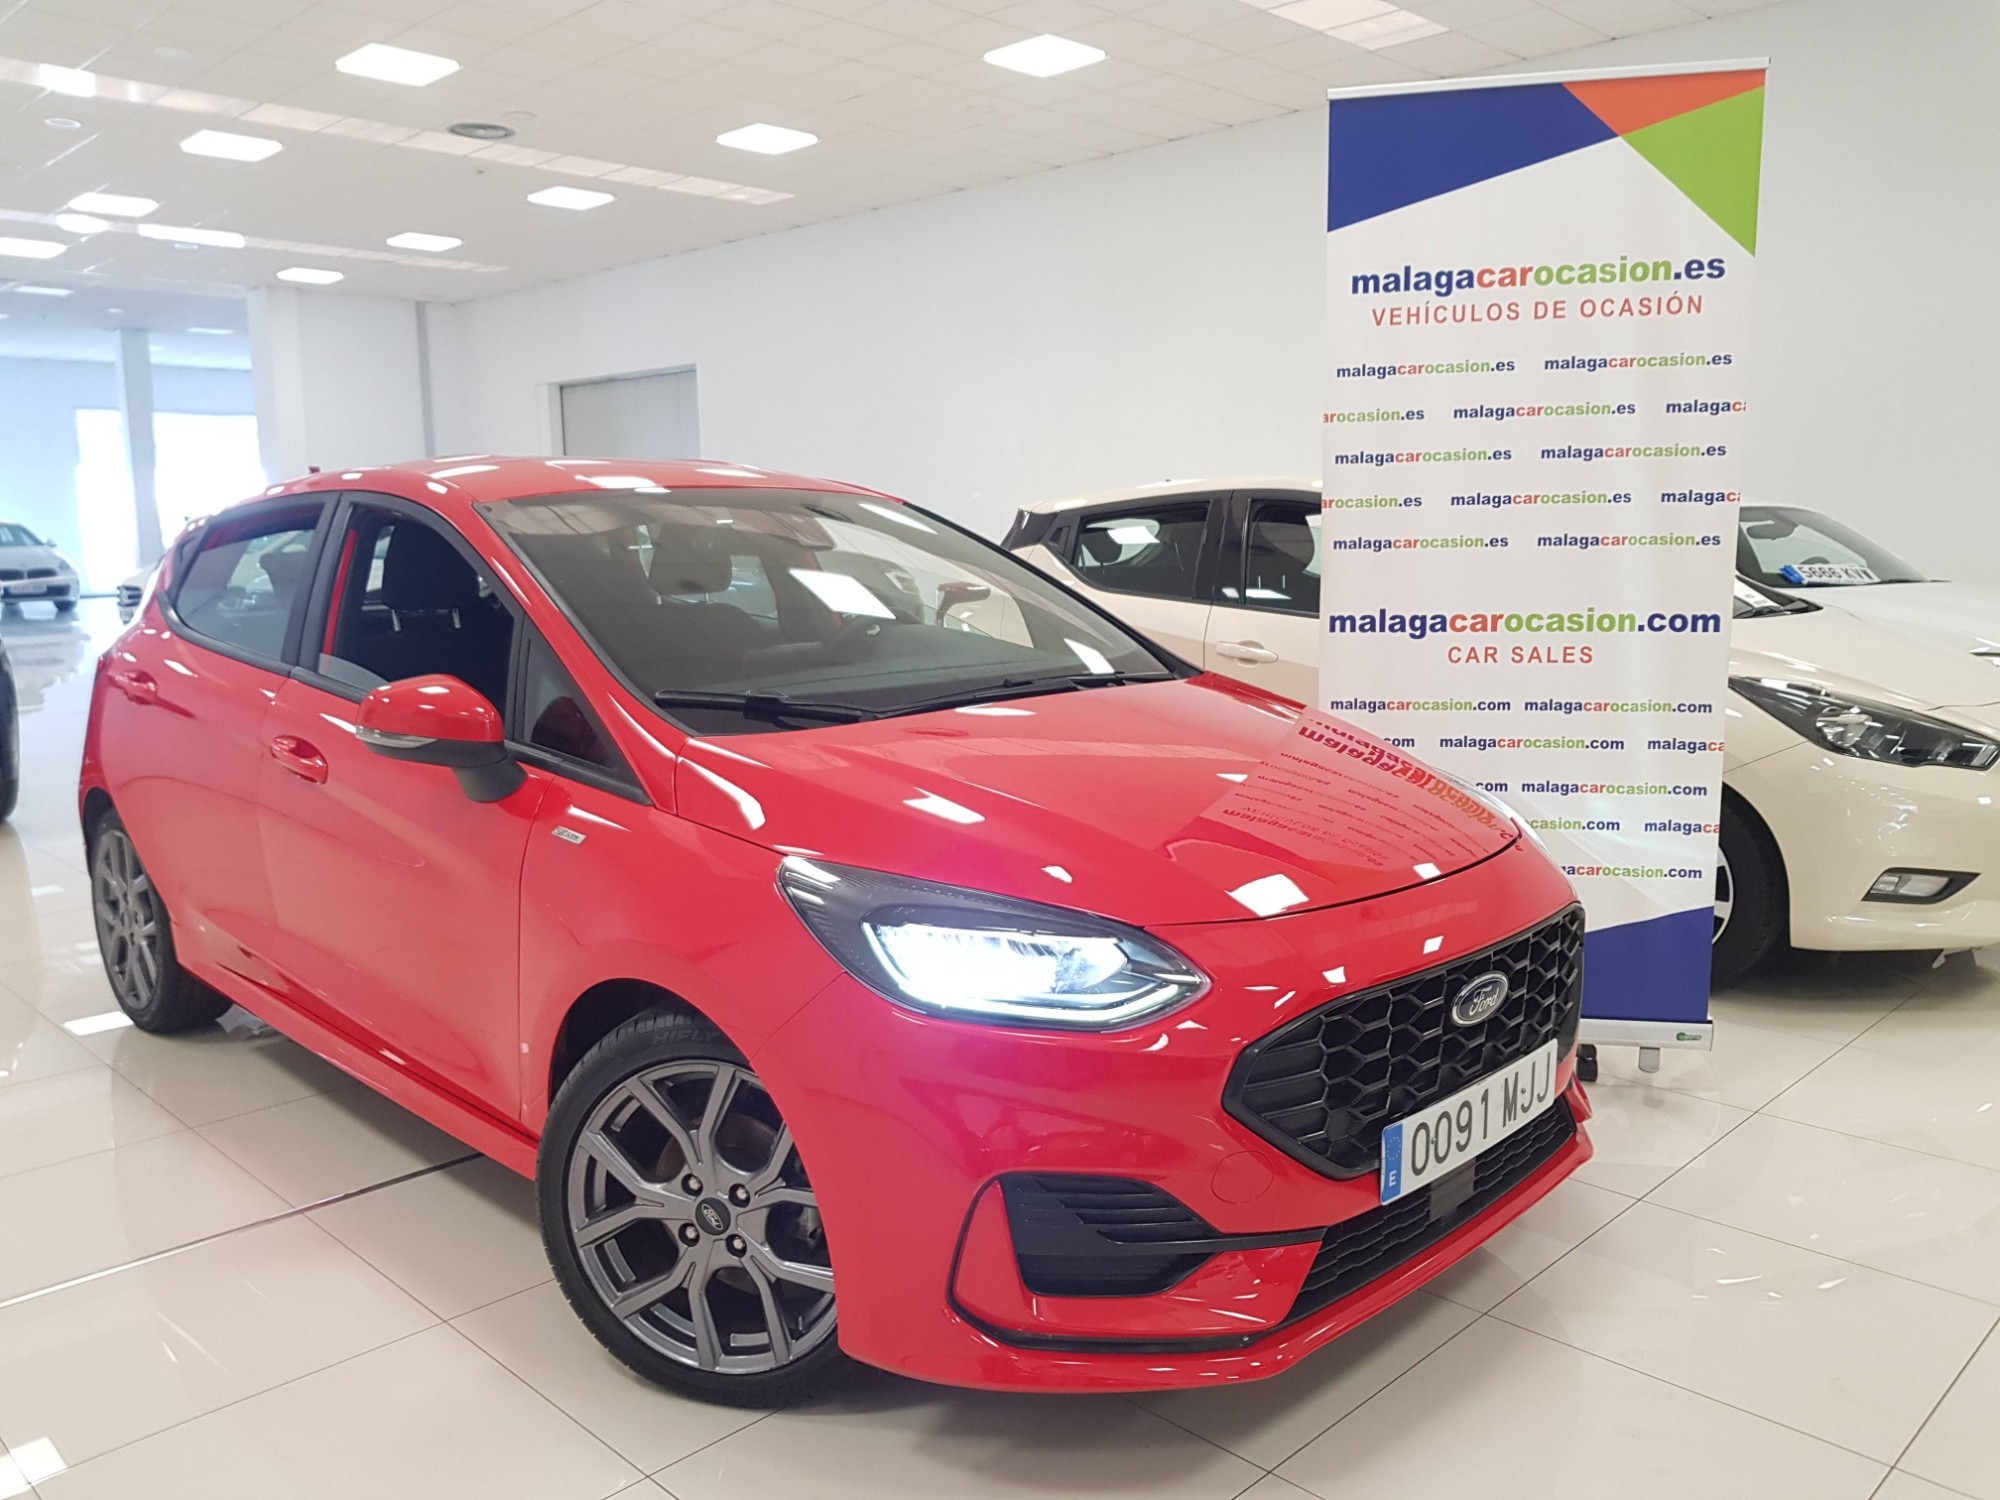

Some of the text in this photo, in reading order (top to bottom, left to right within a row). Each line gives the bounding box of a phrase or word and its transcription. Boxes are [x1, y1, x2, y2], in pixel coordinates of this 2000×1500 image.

[1351, 255, 1726, 298] malagacarocasion.es
[1372, 291, 1702, 327] VEHÍCULOS DE OCASIÓN
[1336, 352, 1732, 378] malagacarocasion.es malagacarocasion.es
[1453, 401, 1636, 421] malagacarocasion.es
[1334, 443, 1727, 467] malagacarocasion.es malagacarocasion.es
[1450, 490, 1632, 509] malagacarocasion.es
[1333, 532, 1721, 553] malagacarocasion.es malagacarocasion.es
[1329, 606, 1721, 640] malagacarocasion.com
[1447, 646, 1593, 664] CAR SALES
[1330, 697, 1713, 715] malagacarocasion.com malagacarocasion.com
[1439, 735, 1625, 752] malagacarocasion.com
[1521, 780, 1708, 797] malagacarocasion.com
[1469, 985, 1499, 1016] Ford
[1411, 1052, 1551, 1176] 0091 MJJ
[1389, 1170, 1397, 1187] E
